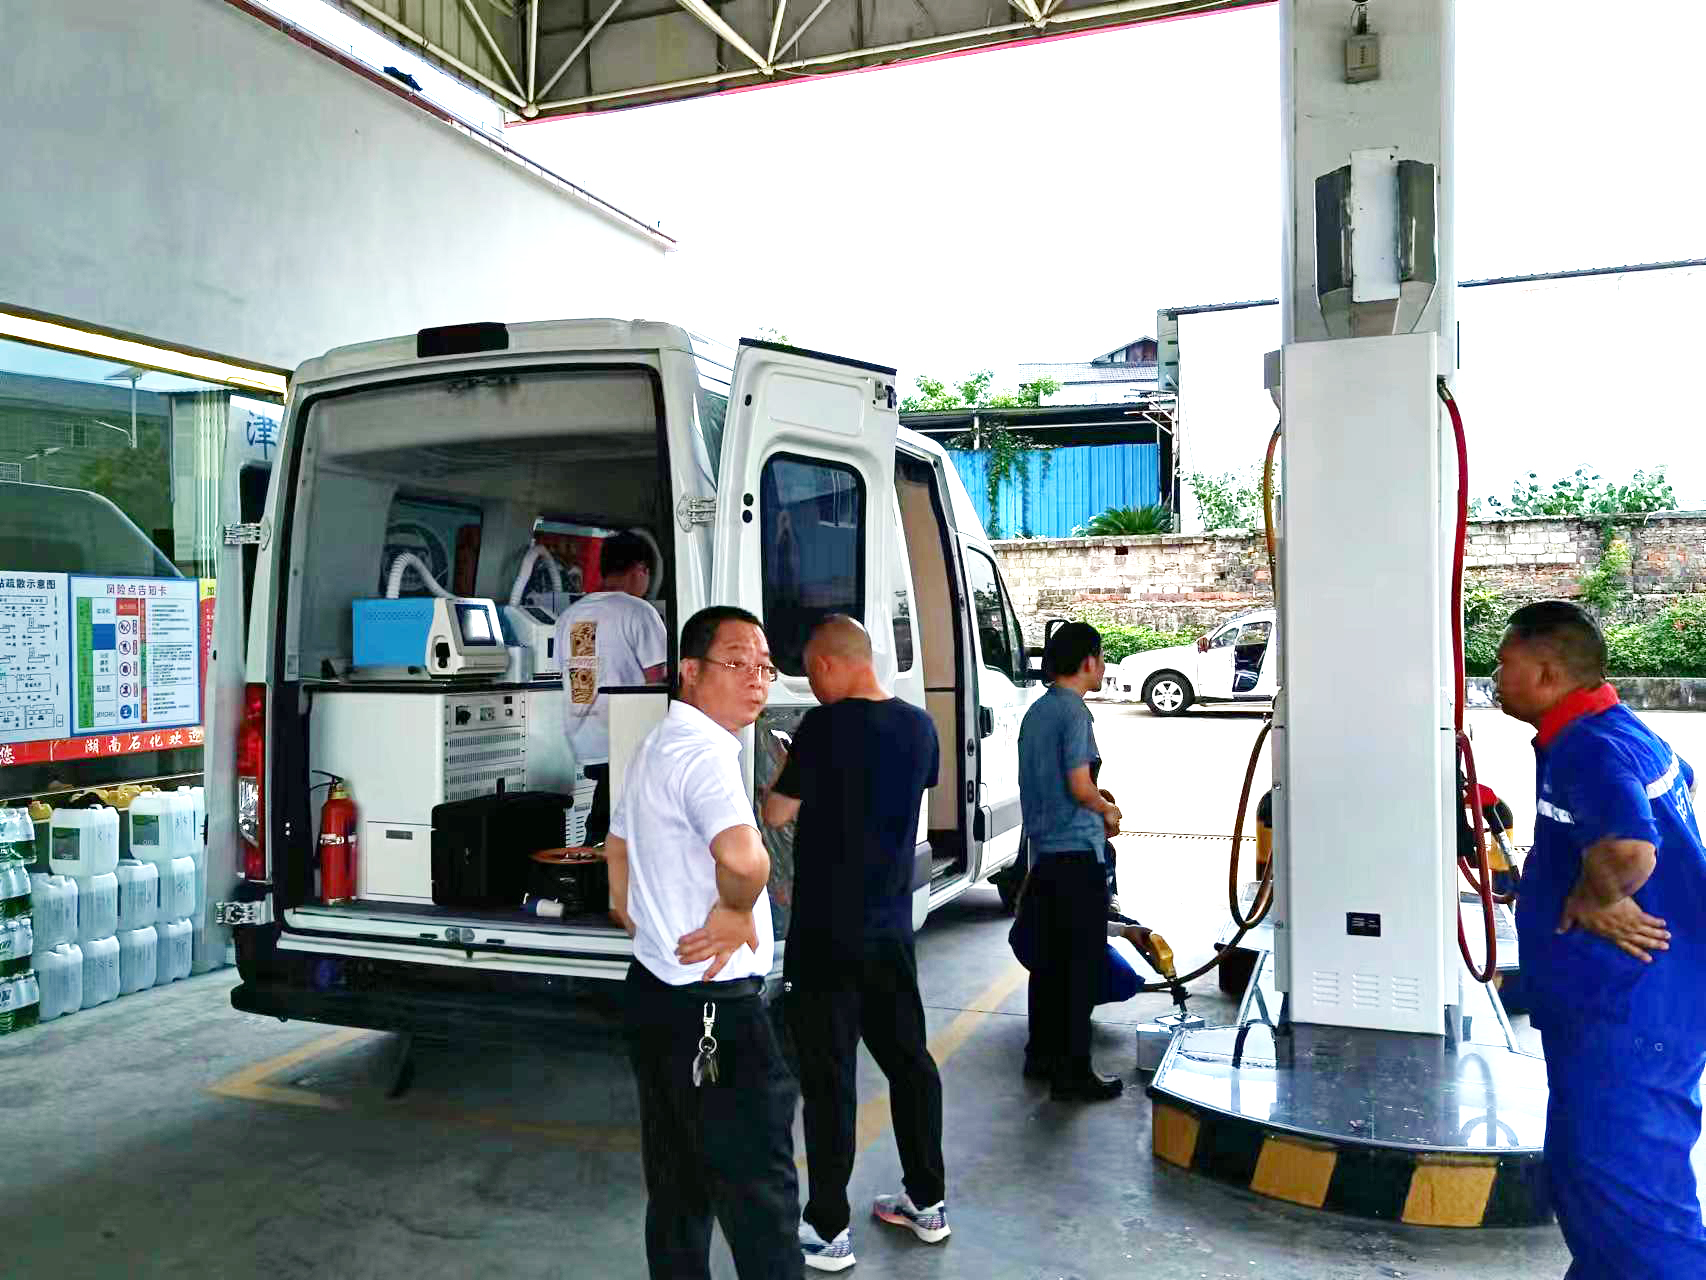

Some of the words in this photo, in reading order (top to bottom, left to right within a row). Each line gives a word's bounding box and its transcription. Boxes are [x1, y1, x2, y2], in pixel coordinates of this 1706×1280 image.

[246, 407, 278, 461] 津
[106, 583, 168, 596] 风险点告知卡
[85, 728, 203, 754] 湖南石化欢迎
